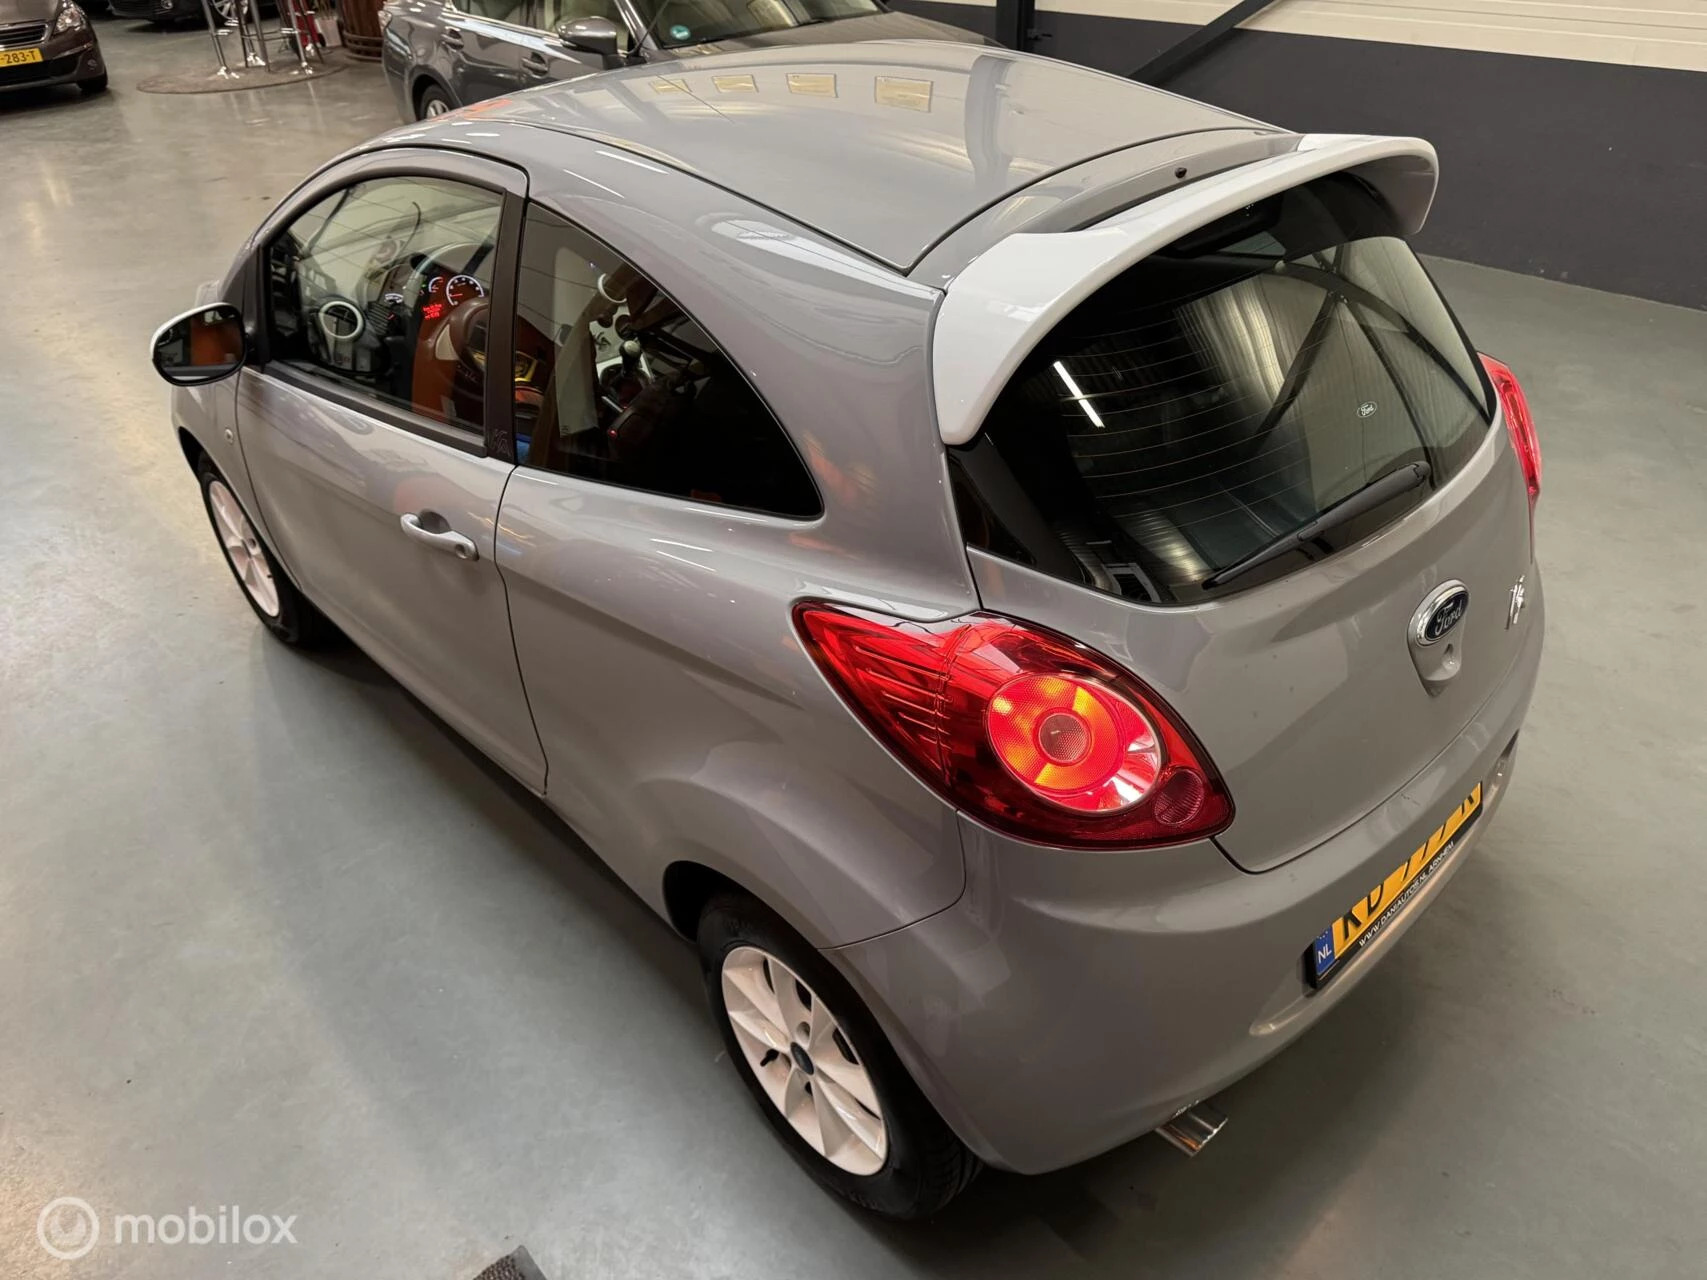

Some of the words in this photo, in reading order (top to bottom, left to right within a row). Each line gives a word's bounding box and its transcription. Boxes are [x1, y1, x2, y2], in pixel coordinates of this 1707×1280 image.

[1360, 402, 1375, 416] Ford
[1435, 600, 1463, 636] Ford
[1318, 943, 1332, 964] NL
